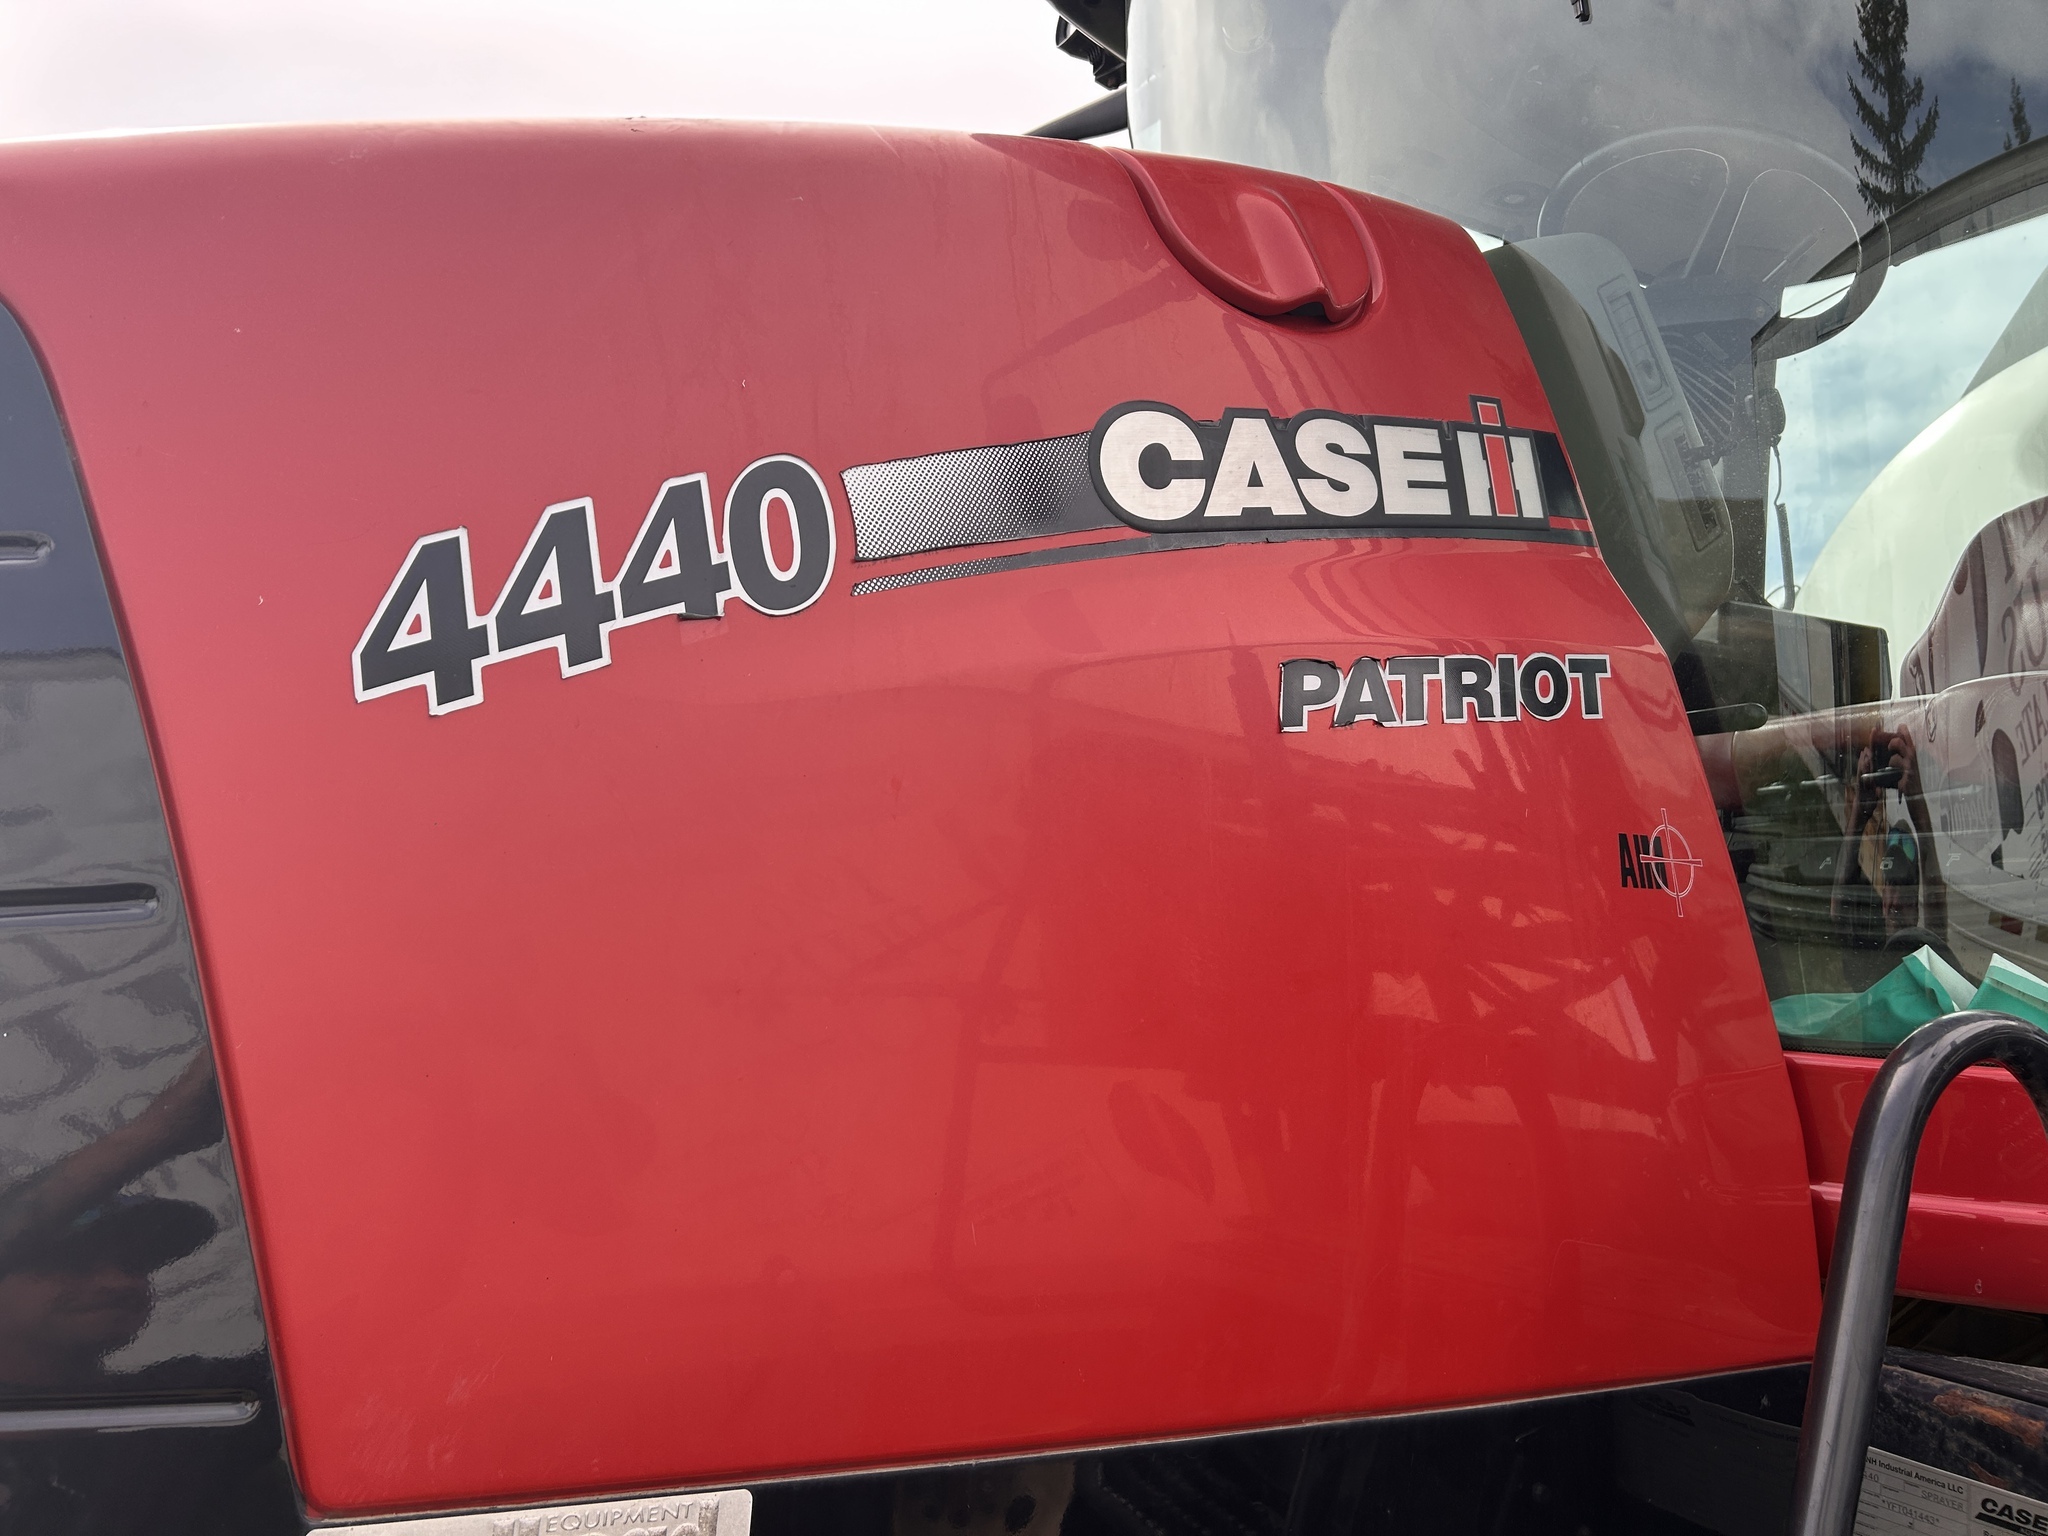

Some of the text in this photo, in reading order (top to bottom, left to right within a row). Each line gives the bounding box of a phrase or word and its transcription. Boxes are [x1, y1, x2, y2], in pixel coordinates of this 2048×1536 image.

[1100, 410, 1452, 521] CASE
[351, 453, 836, 716] 4440
[1279, 653, 1610, 733] PATRIOT
[1865, 1456, 1877, 1467] NH
[1879, 1460, 1913, 1478] Industrial
[1914, 1472, 1946, 1490] America
[1947, 1482, 1964, 1495] LLC
[545, 1500, 694, 1534] EQUIPMENT
[1921, 1490, 1964, 1512] SPRAYER
[1981, 1498, 2048, 1532] CASE
